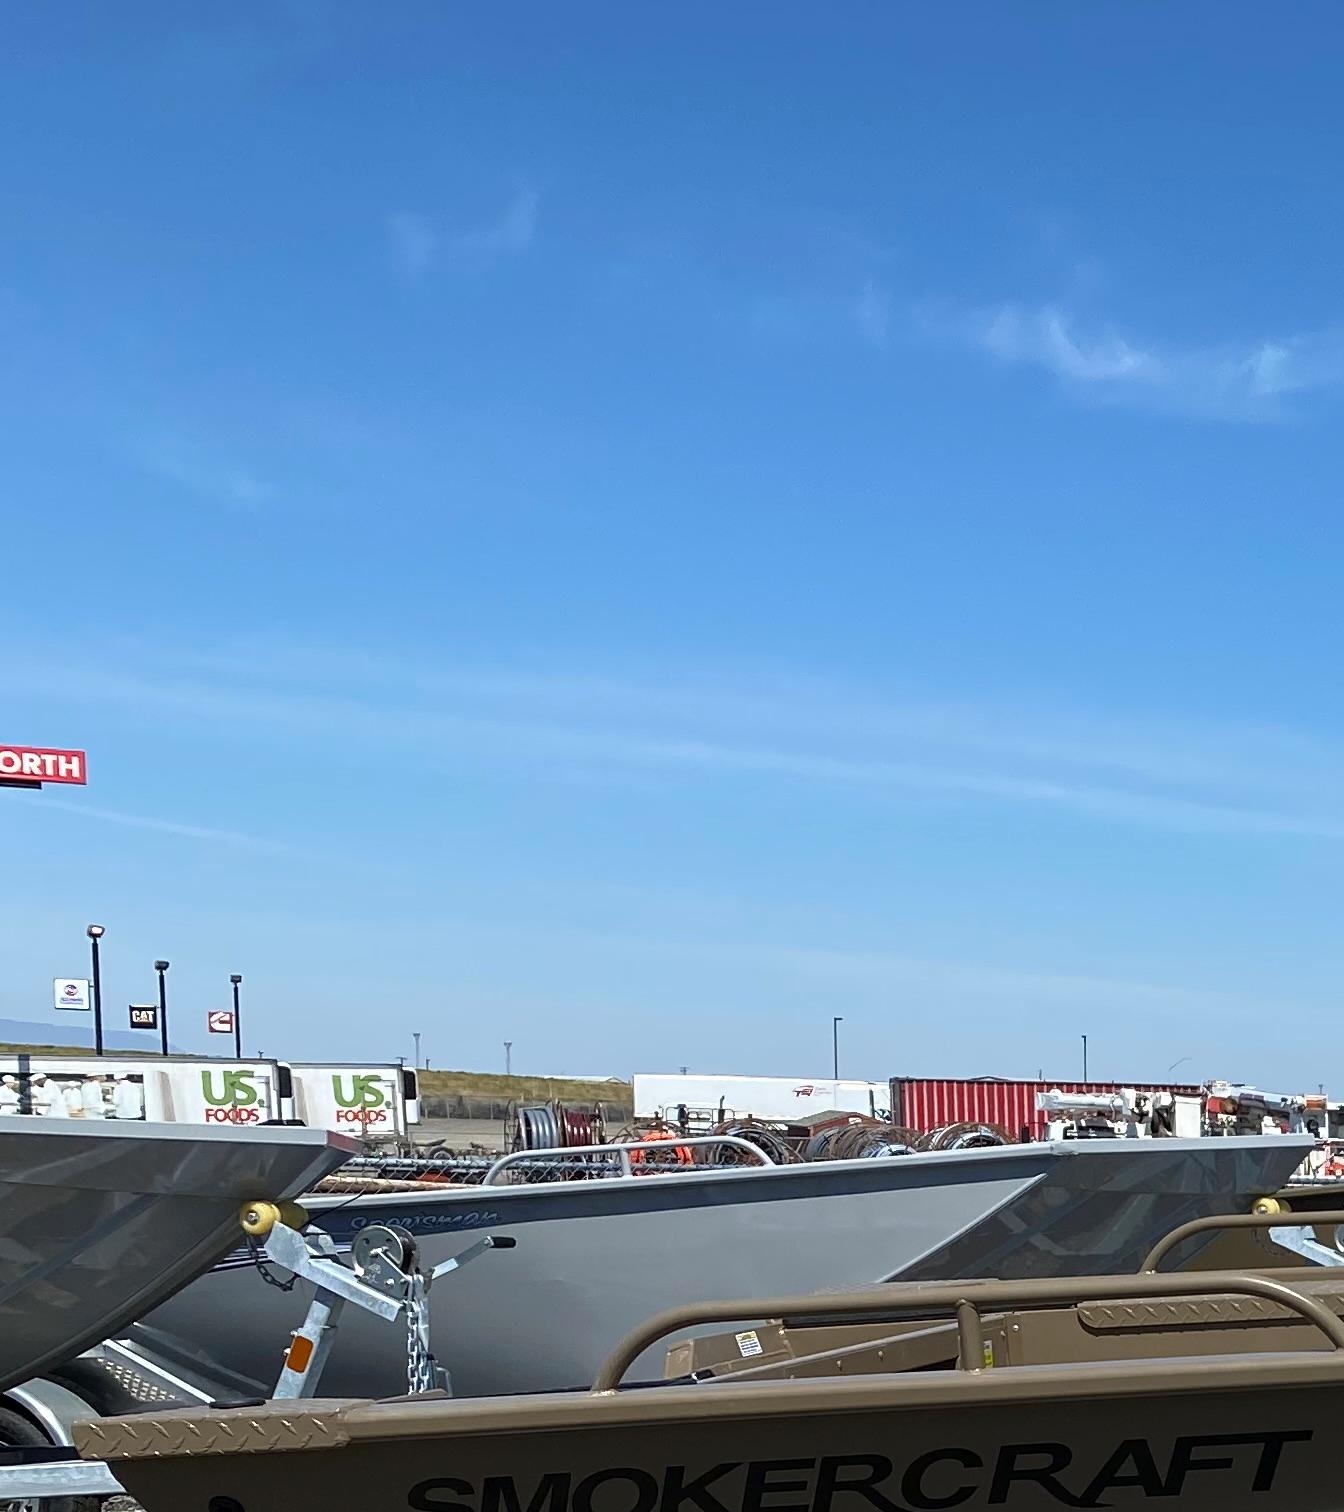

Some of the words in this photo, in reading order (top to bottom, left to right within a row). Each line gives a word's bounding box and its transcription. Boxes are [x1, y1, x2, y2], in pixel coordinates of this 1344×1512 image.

[132, 1010, 154, 1023] CAT
[204, 1108, 260, 1123] FOODS
[336, 1109, 387, 1123] FOODS
